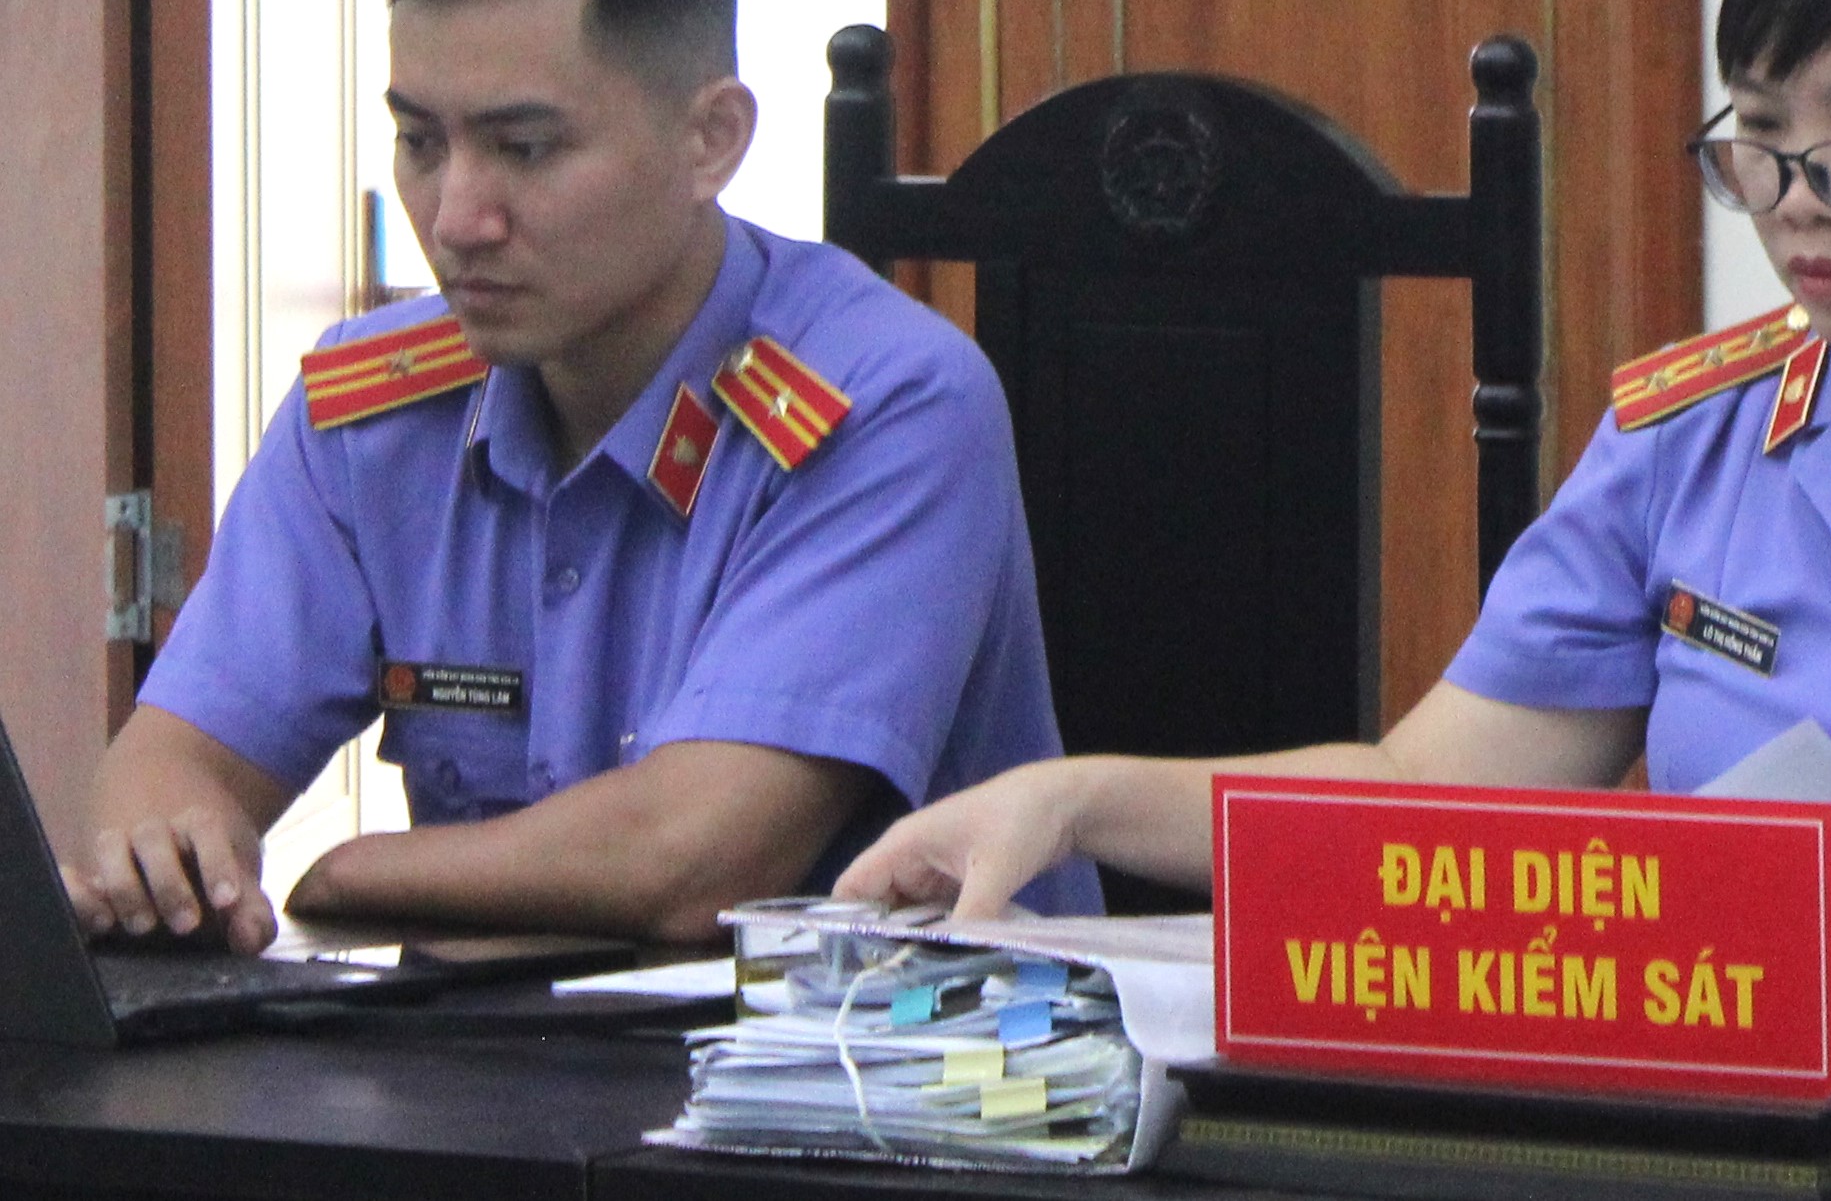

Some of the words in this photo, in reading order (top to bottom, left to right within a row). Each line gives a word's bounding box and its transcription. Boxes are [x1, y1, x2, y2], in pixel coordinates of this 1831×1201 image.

[1377, 843, 1486, 923] ĐẠI
[1513, 838, 1661, 931] DIỆN
[1286, 928, 1431, 1020] VIỆN
[1458, 925, 1618, 1020] KIỂM
[1643, 949, 1764, 1028] SÁT
